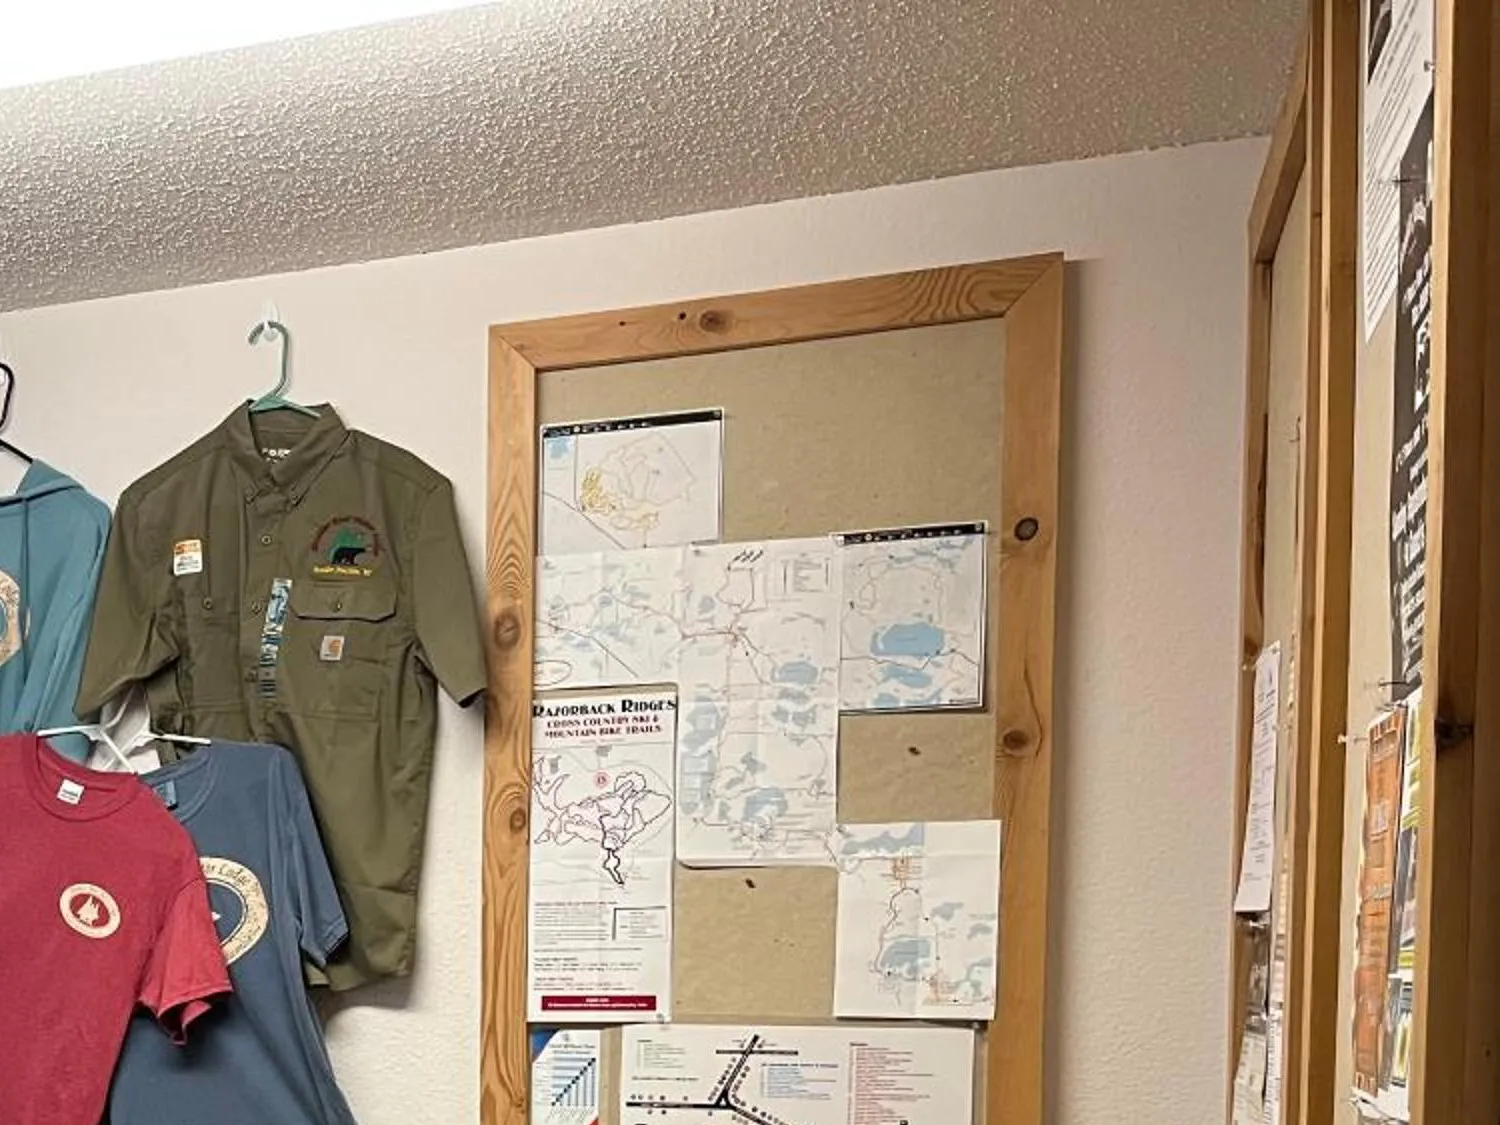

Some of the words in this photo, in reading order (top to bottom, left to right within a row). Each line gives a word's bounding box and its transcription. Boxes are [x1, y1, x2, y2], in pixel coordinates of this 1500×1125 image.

[532, 703, 616, 718] RAZORBACK
[621, 699, 677, 713] RIDGES
[547, 719, 581, 729] CROSS
[583, 716, 629, 728] COUNTRY
[632, 715, 650, 724] SKI
[545, 728, 597, 739] MOUNTAIN
[599, 726, 622, 736] BIKE
[625, 725, 662, 735] TRAILS
